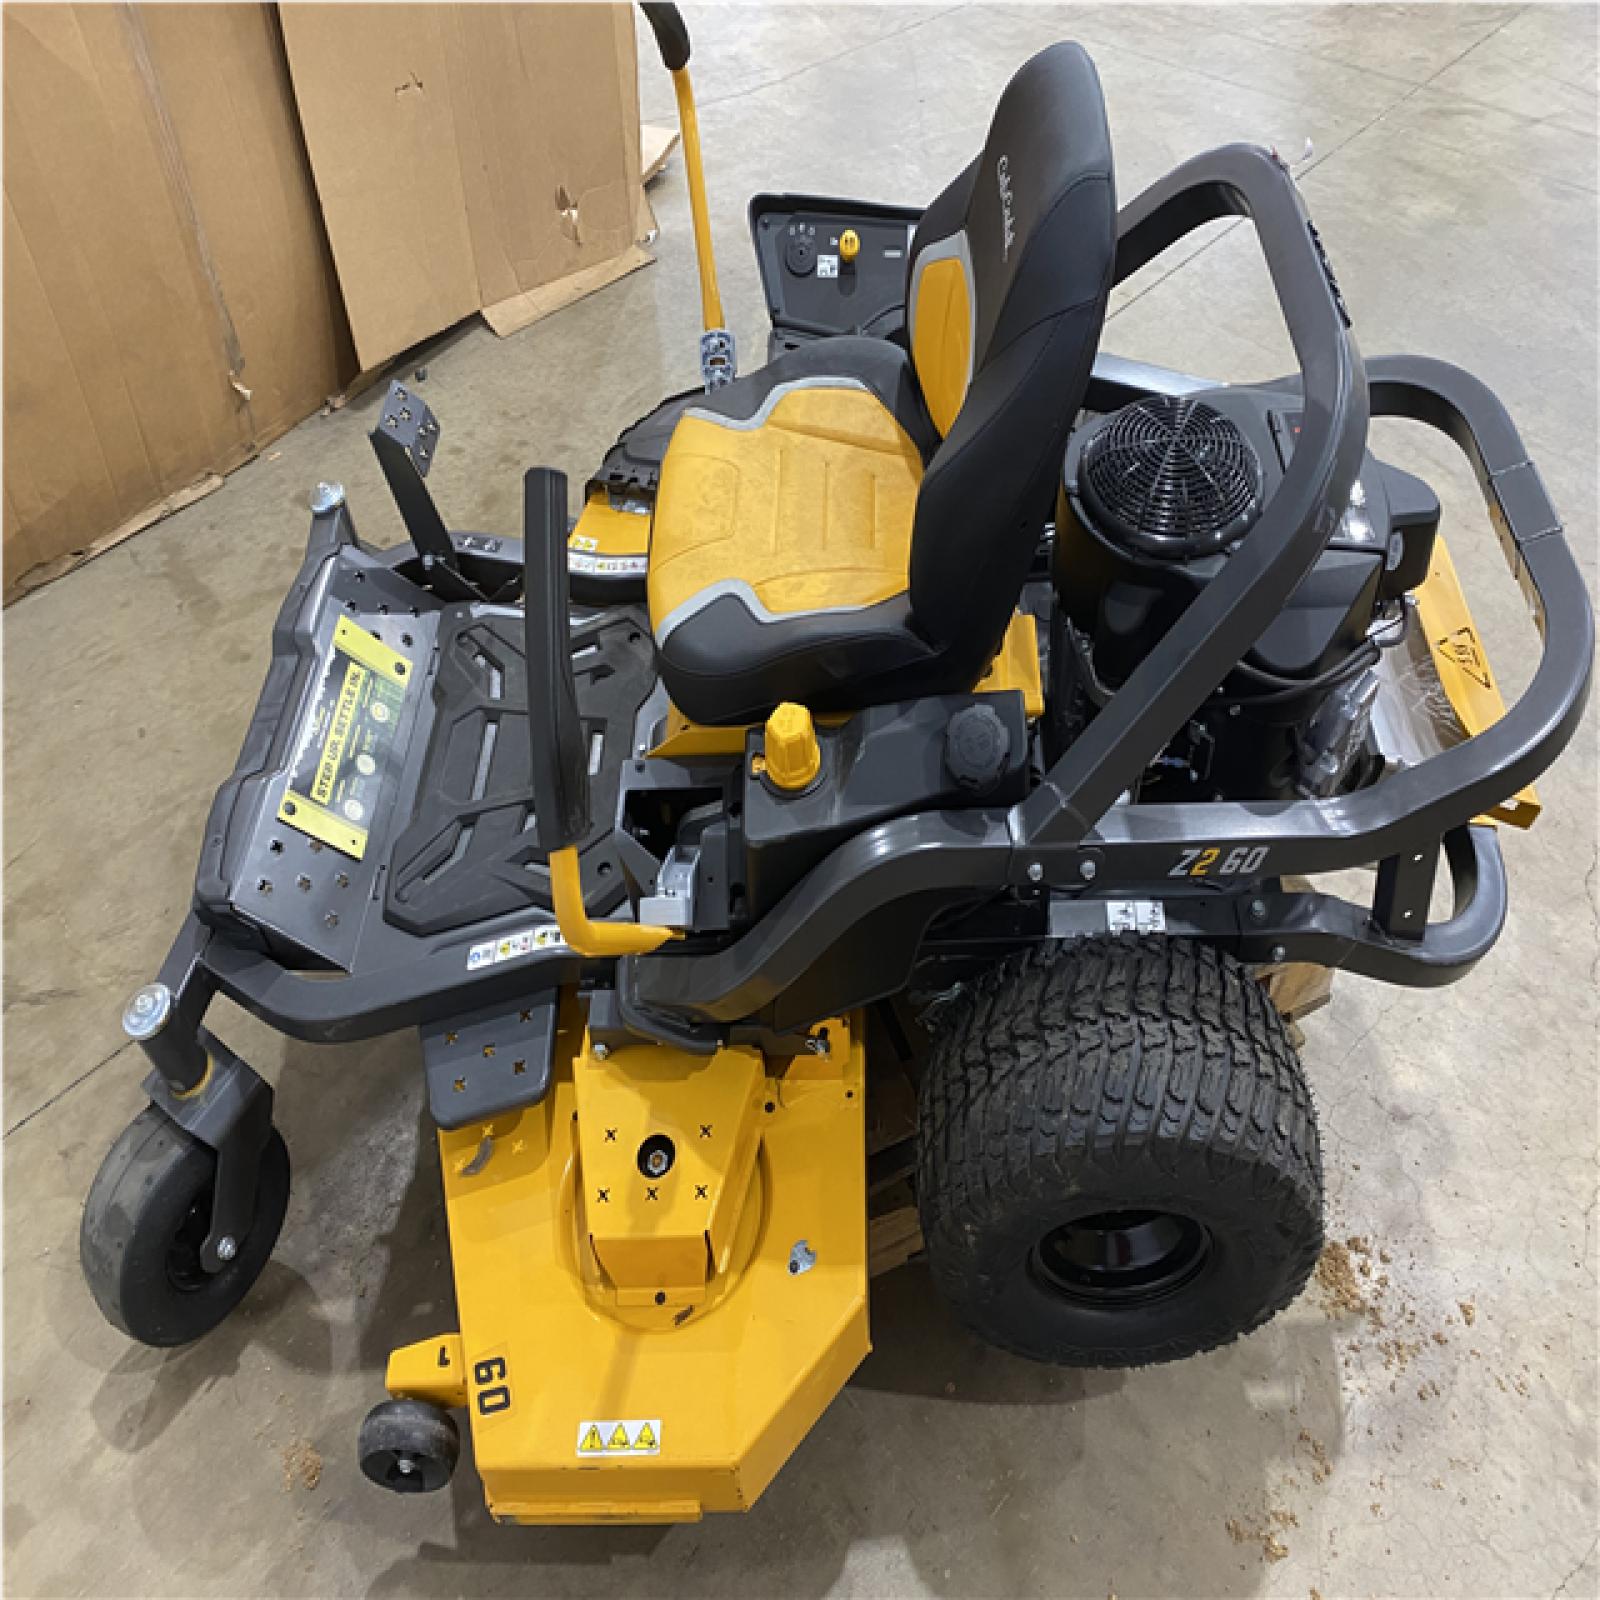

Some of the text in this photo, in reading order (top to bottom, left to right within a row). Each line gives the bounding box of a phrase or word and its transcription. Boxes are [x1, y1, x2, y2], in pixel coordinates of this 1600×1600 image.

[1168, 847, 1270, 875] Z2 60
[474, 1357, 510, 1415] 60
